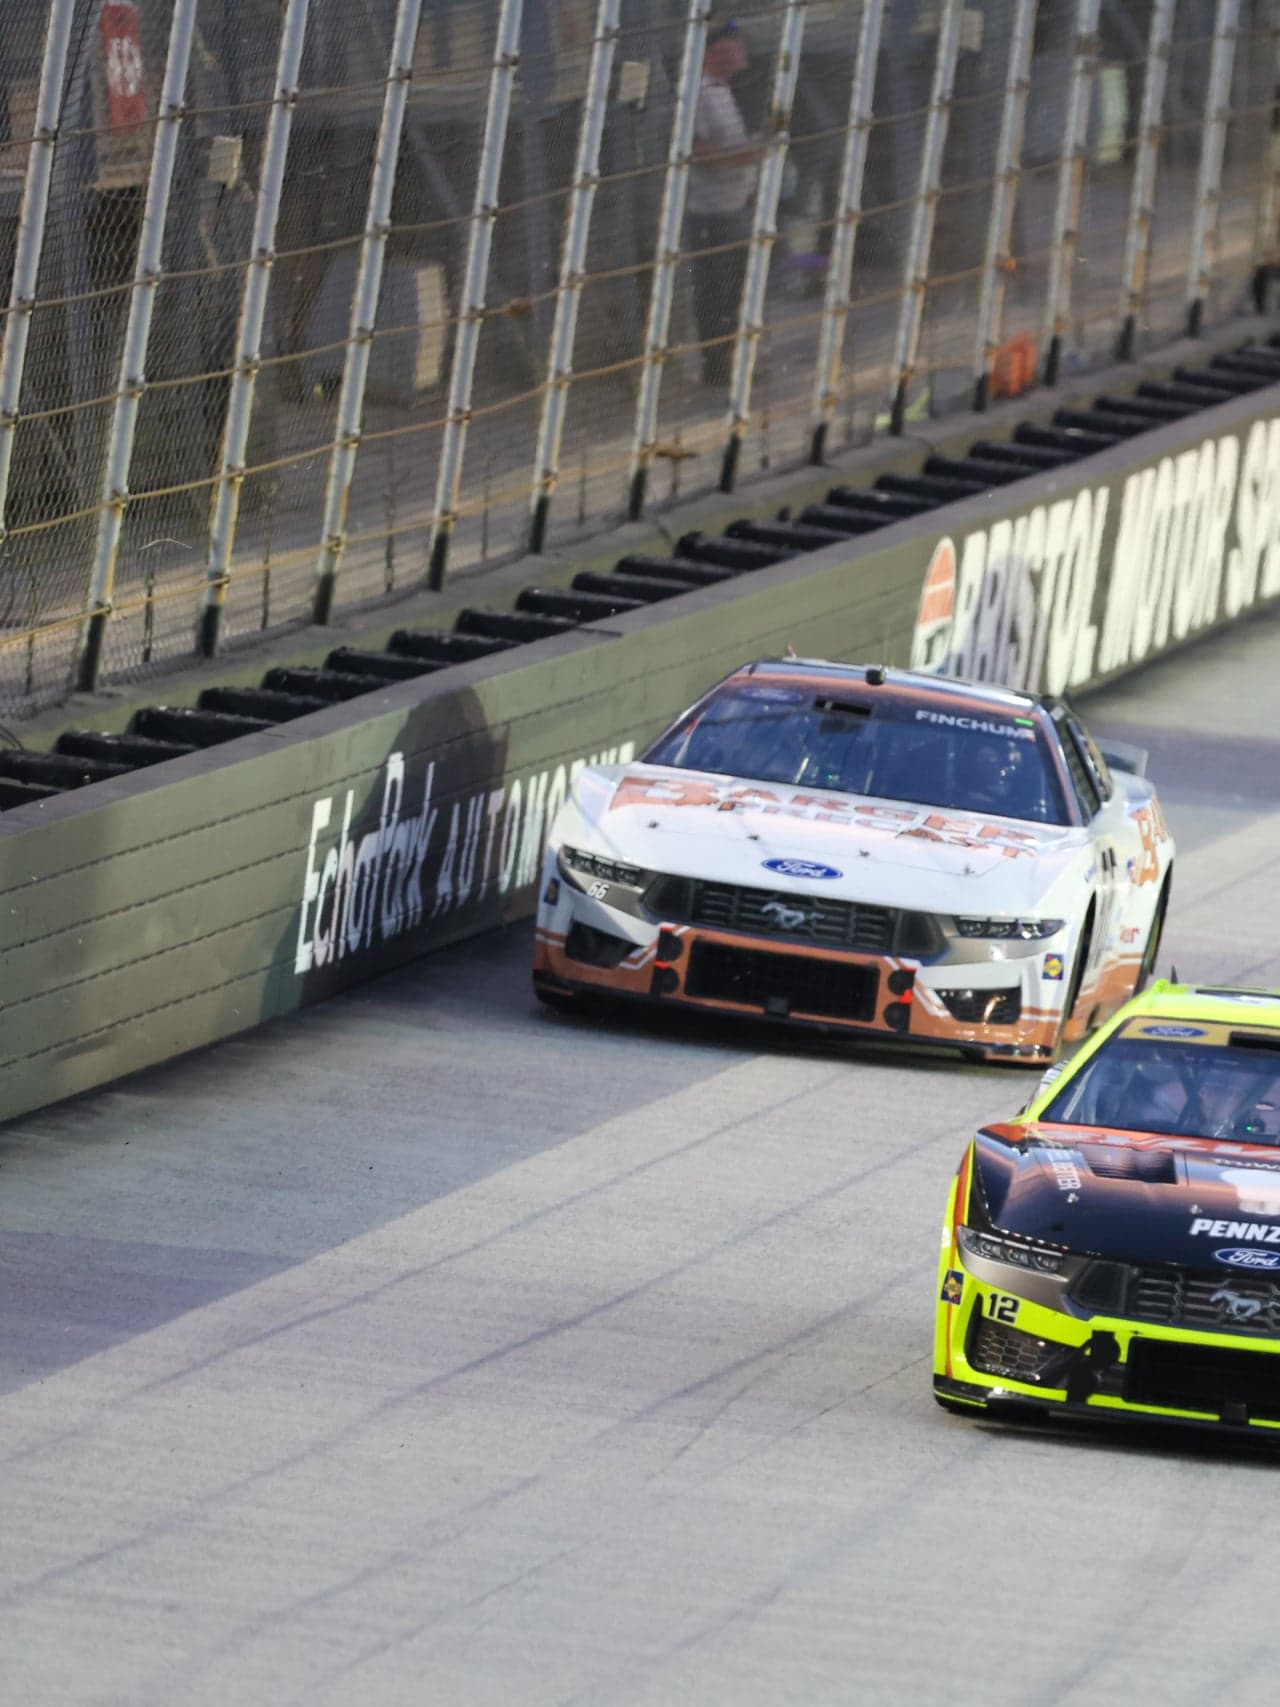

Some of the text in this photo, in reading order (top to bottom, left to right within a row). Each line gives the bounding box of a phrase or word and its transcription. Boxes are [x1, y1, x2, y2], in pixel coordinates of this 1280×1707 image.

[946, 487, 1109, 696] BRISTOL
[1099, 435, 1240, 674] MOTOR
[914, 709, 1036, 738] FINCHUM
[294, 752, 438, 975] EchoPark
[775, 860, 829, 879] Ford
[588, 881, 609, 900] 66
[1227, 1249, 1280, 1267] Ford
[988, 1293, 1020, 1324] 12
